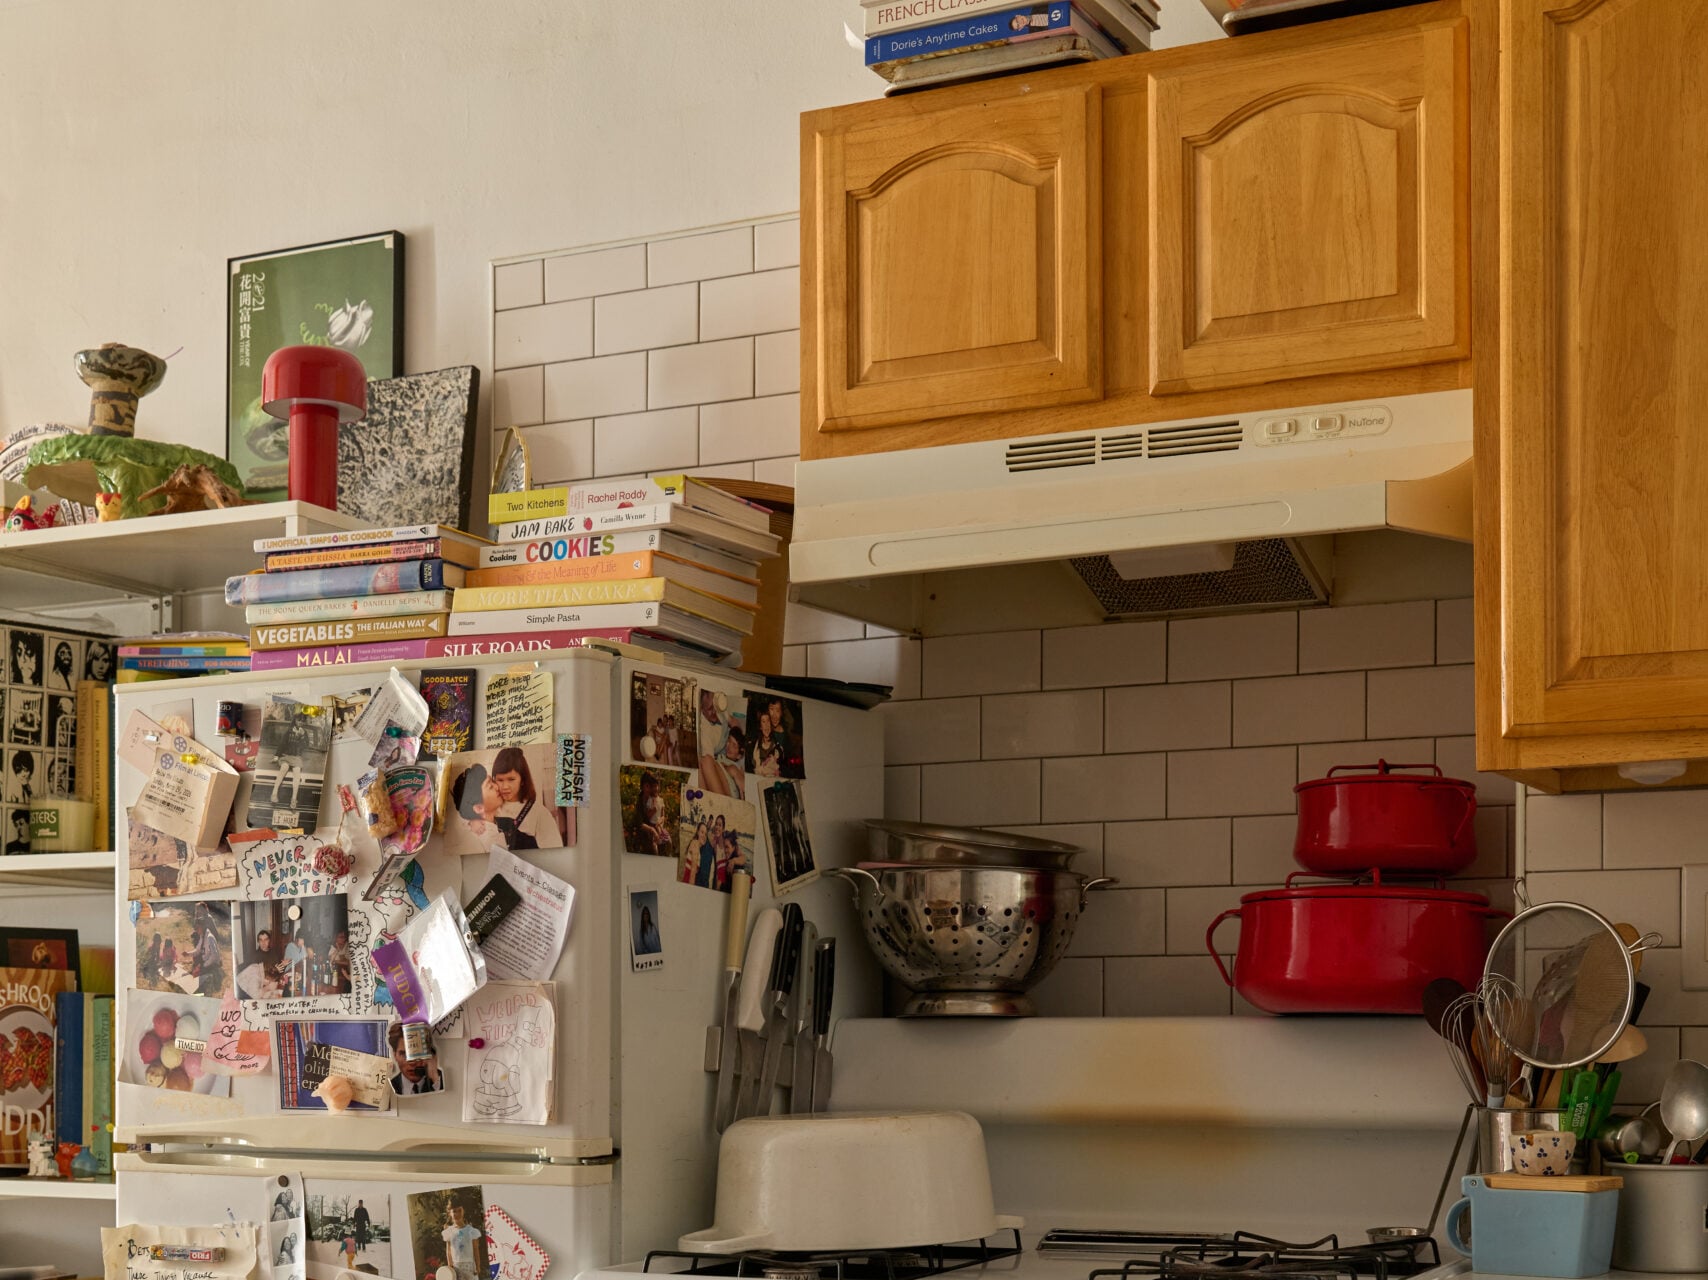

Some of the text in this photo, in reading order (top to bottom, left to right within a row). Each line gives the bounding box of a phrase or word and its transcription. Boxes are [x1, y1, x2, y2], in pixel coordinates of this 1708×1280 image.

[878, 1, 935, 24] FRENCH
[891, 37, 923, 52] Dorie's
[926, 30, 965, 46] Anytime
[968, 23, 998, 37] Cakes
[1349, 416, 1386, 428] NuTone
[507, 489, 647, 511] Two Kitchens Rachel Roddy
[511, 512, 646, 539] JAM BAKE Camilla Wynne
[267, 530, 394, 549] UNOFFICIAL SIMPSONS COOKBOOK
[525, 534, 615, 563] COOKIES
[270, 558, 275, 567] A
[276, 556, 300, 566] TASTE
[303, 555, 314, 564] OF
[316, 553, 346, 563] RUSSIA
[489, 553, 517, 562] Cooking
[553, 566, 588, 579] Meaning
[601, 562, 616, 573] Life
[478, 583, 637, 607] MORE THAN CAKE
[273, 606, 297, 615] SCONE
[298, 605, 320, 613] QUEEN
[526, 613, 580, 625] Simple Pasta
[256, 619, 427, 645] VEGETABLES THE ITALIAN WAY
[297, 649, 351, 667] MALAI
[443, 643, 486, 659] SILK
[489, 639, 551, 655] ROADS
[424, 676, 468, 684] GOOD BATCH
[508, 702, 531, 713] BOOKS
[561, 740, 573, 801] BAZAAR
[253, 845, 306, 878] NEVER
[513, 865, 535, 883] Events
[542, 881, 567, 901] Classes
[388, 964, 421, 1019] JUDGE
[476, 993, 537, 1023] WEIRD
